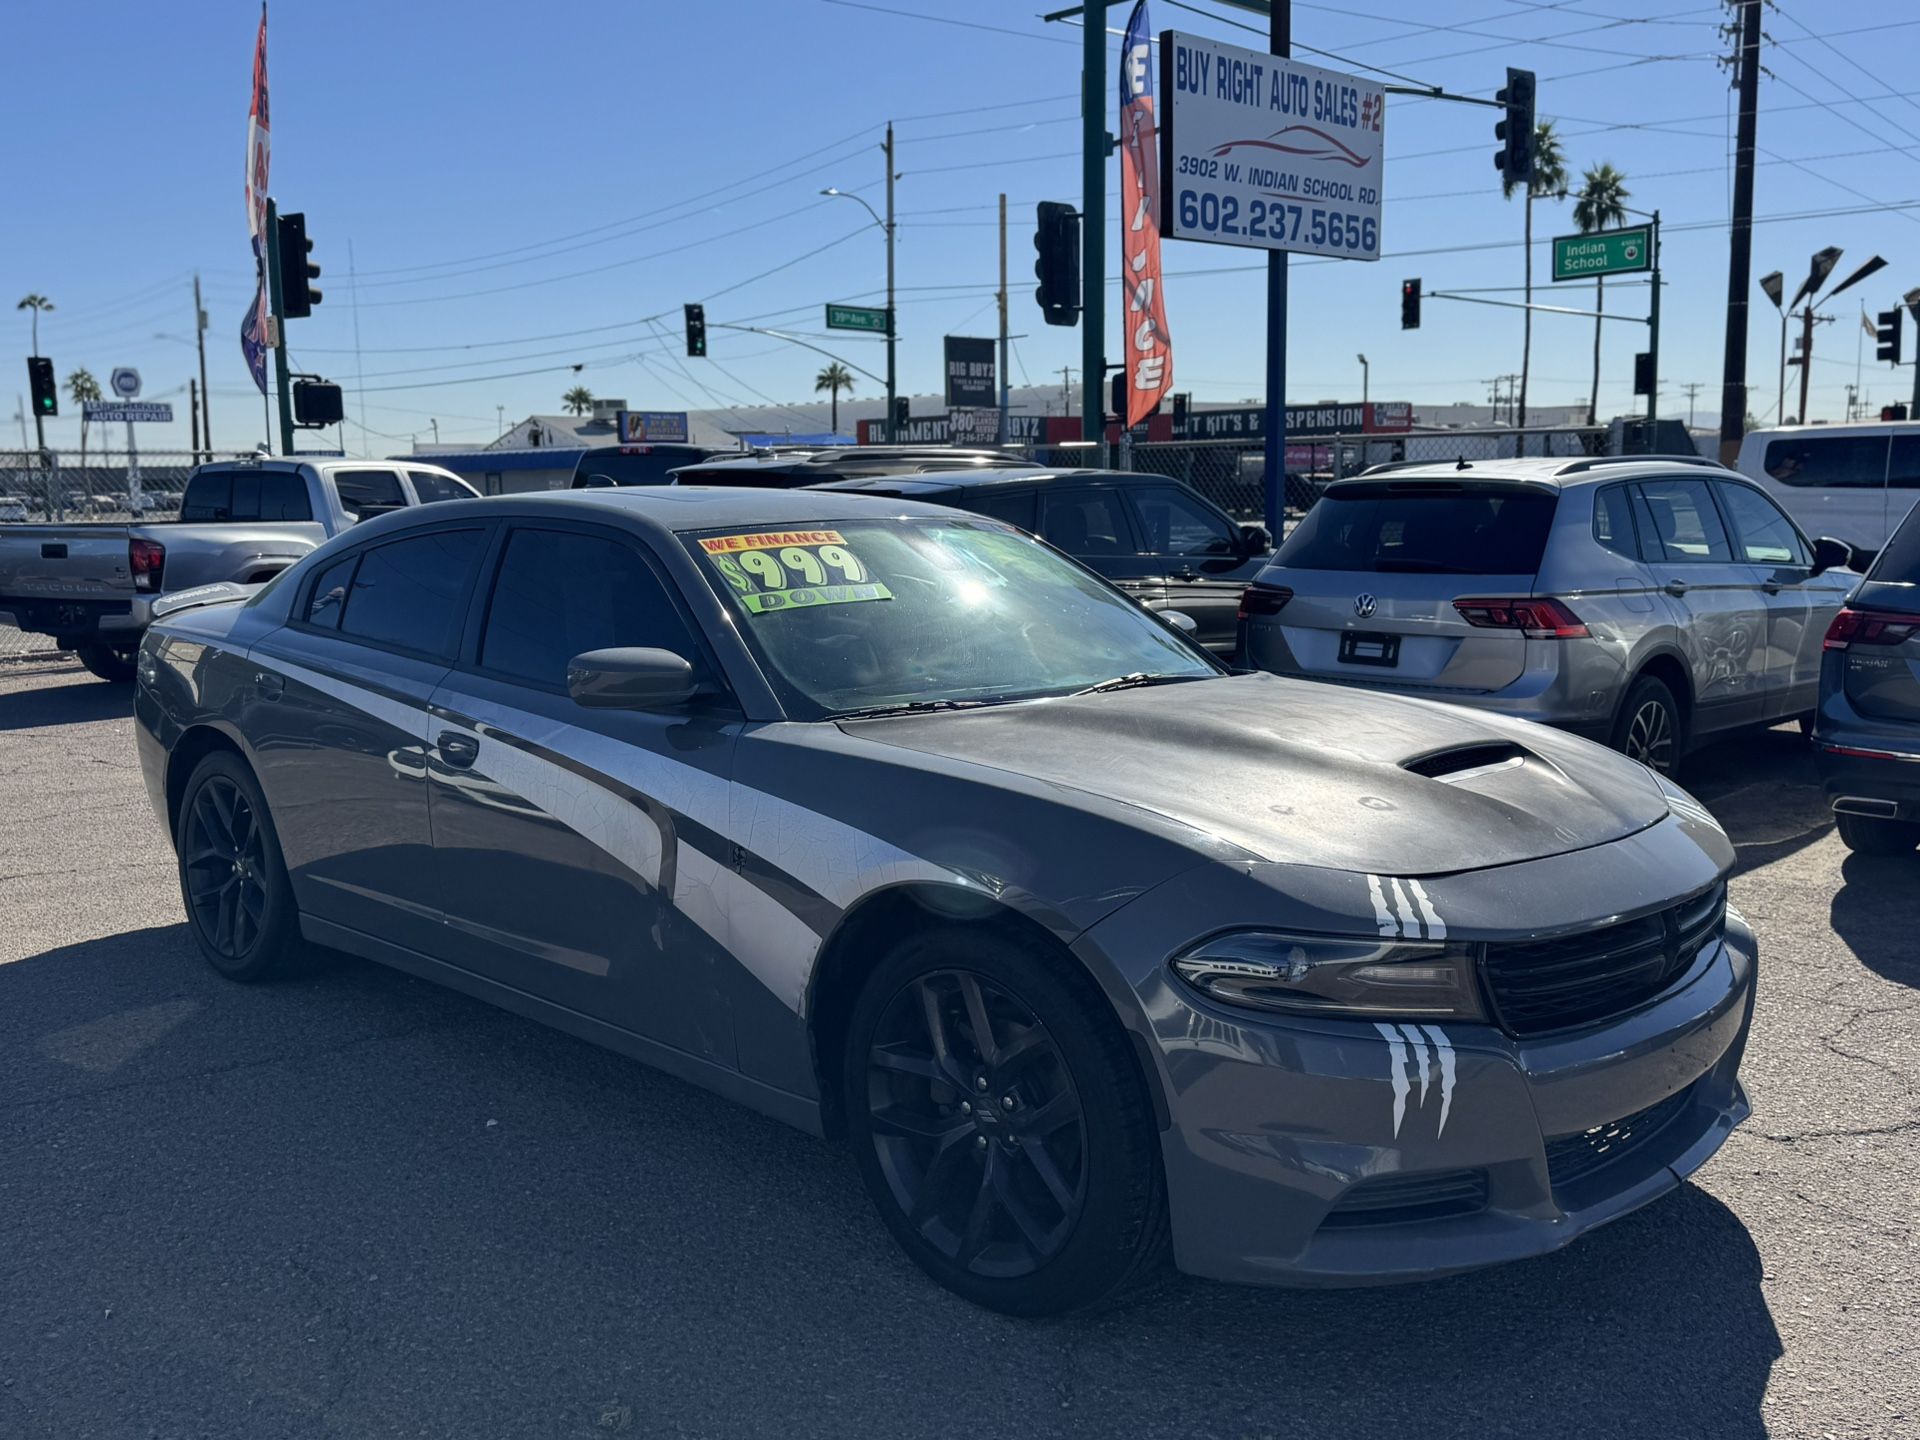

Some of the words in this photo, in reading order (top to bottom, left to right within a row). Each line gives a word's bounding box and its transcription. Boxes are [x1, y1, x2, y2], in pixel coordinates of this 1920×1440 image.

[1176, 46, 1211, 96] BUY
[1216, 56, 1263, 108] RIGHT
[1269, 69, 1309, 118] AUTO
[1313, 79, 1358, 129] SALES
[1361, 92, 1382, 132] #2
[1180, 156, 1218, 179] 3902
[1223, 163, 1243, 184] W.
[1248, 167, 1299, 192] INDIAN
[1302, 176, 1354, 201] SCHOOL
[1179, 189, 1377, 251] 602.237.5656
[1566, 242, 1606, 257] Indian
[1564, 254, 1608, 270] School
[950, 361, 967, 376] BIG
[91, 412, 123, 422] AUTO
[126, 412, 171, 422] REPAIR
[950, 411, 974, 431] $80
[1007, 417, 1039, 437] OYZ
[1206, 414, 1242, 436] KIT'S
[1249, 413, 1260, 431] &
[1286, 407, 1364, 429] SPENSION
[701, 537, 738, 552] WE
[743, 531, 839, 548] FINANCE
[718, 544, 869, 594] $999
[758, 583, 882, 610] DOWN
